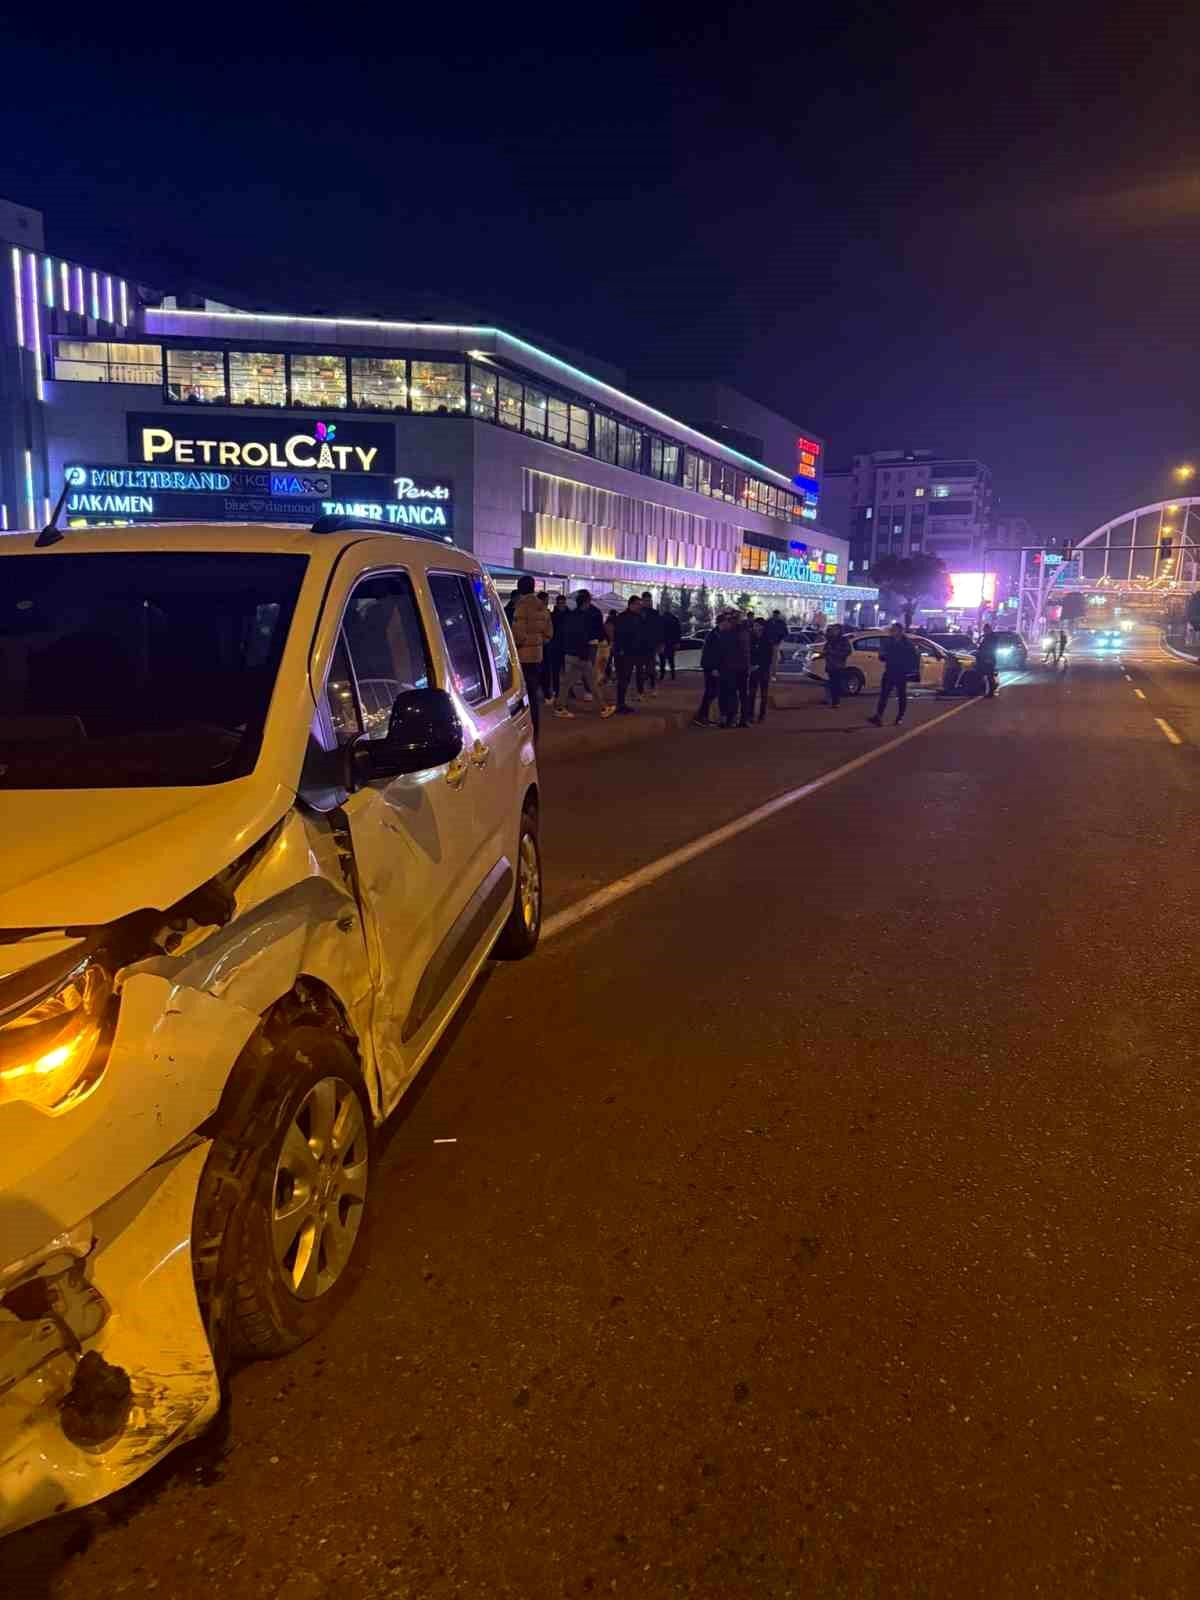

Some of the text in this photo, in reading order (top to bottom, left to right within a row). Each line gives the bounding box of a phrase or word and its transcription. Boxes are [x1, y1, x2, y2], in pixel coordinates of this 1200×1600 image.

[91, 470, 231, 491] MULTIBRAND
[394, 477, 449, 500] Penti
[68, 495, 153, 513] JAKAMEN
[386, 504, 446, 526] TANCA
